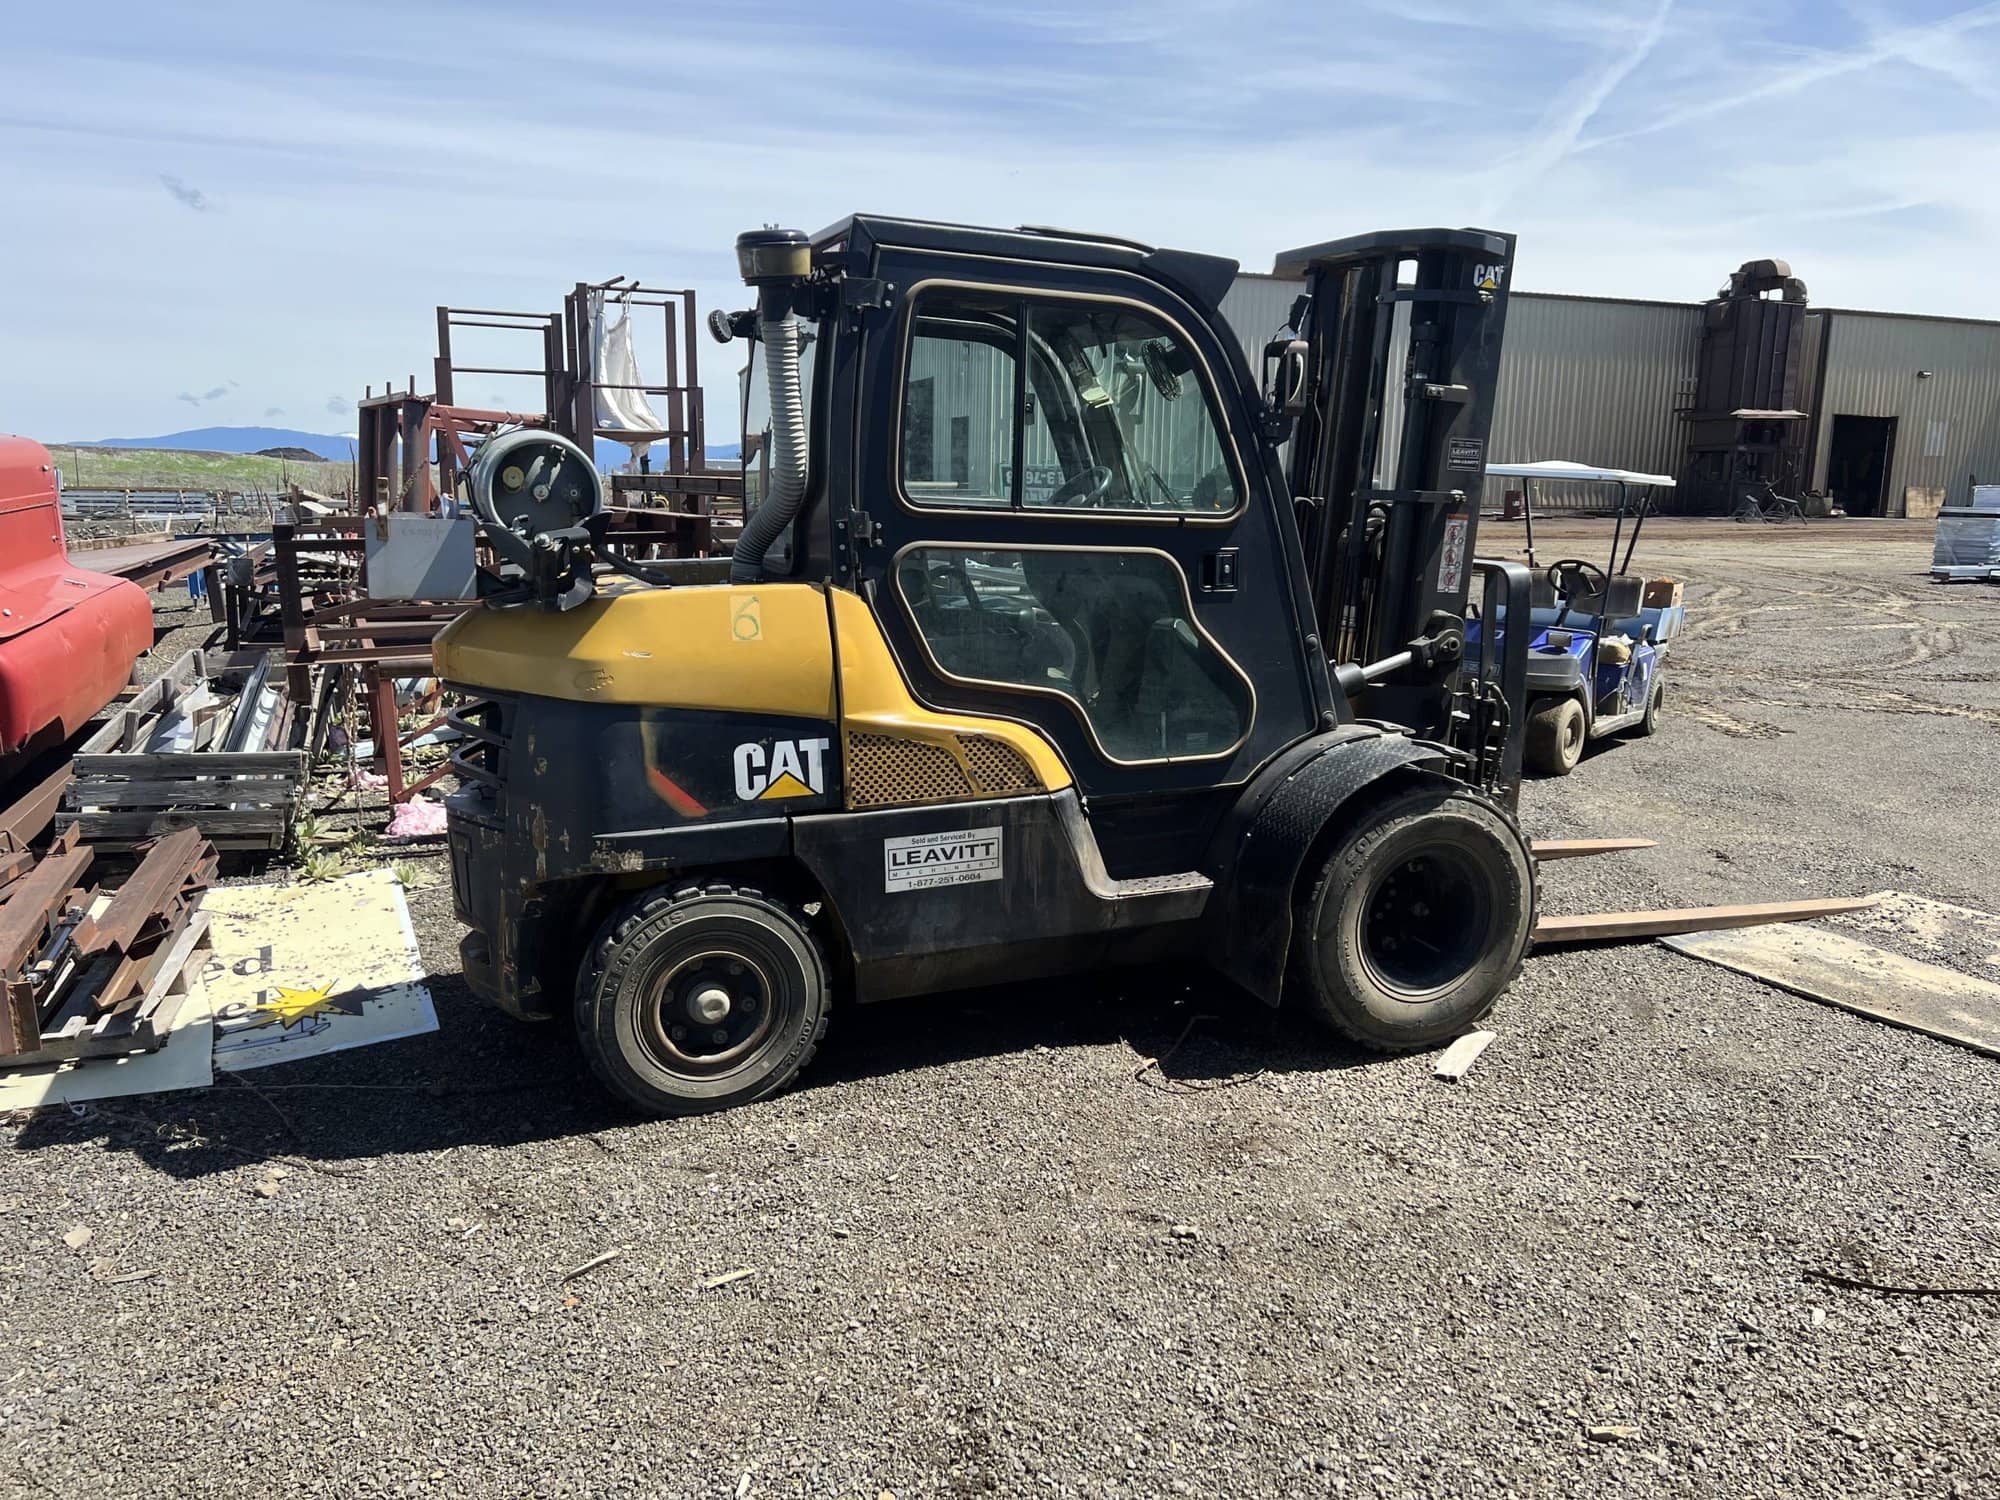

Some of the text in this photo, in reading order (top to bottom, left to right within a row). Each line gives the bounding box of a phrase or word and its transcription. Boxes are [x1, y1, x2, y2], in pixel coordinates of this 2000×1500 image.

[1473, 263, 1505, 287] CAT
[733, 596, 760, 640] 6
[733, 738, 830, 801] CAT
[911, 831, 975, 845] Sold and Serviced By
[892, 842, 995, 867] LEAVITT
